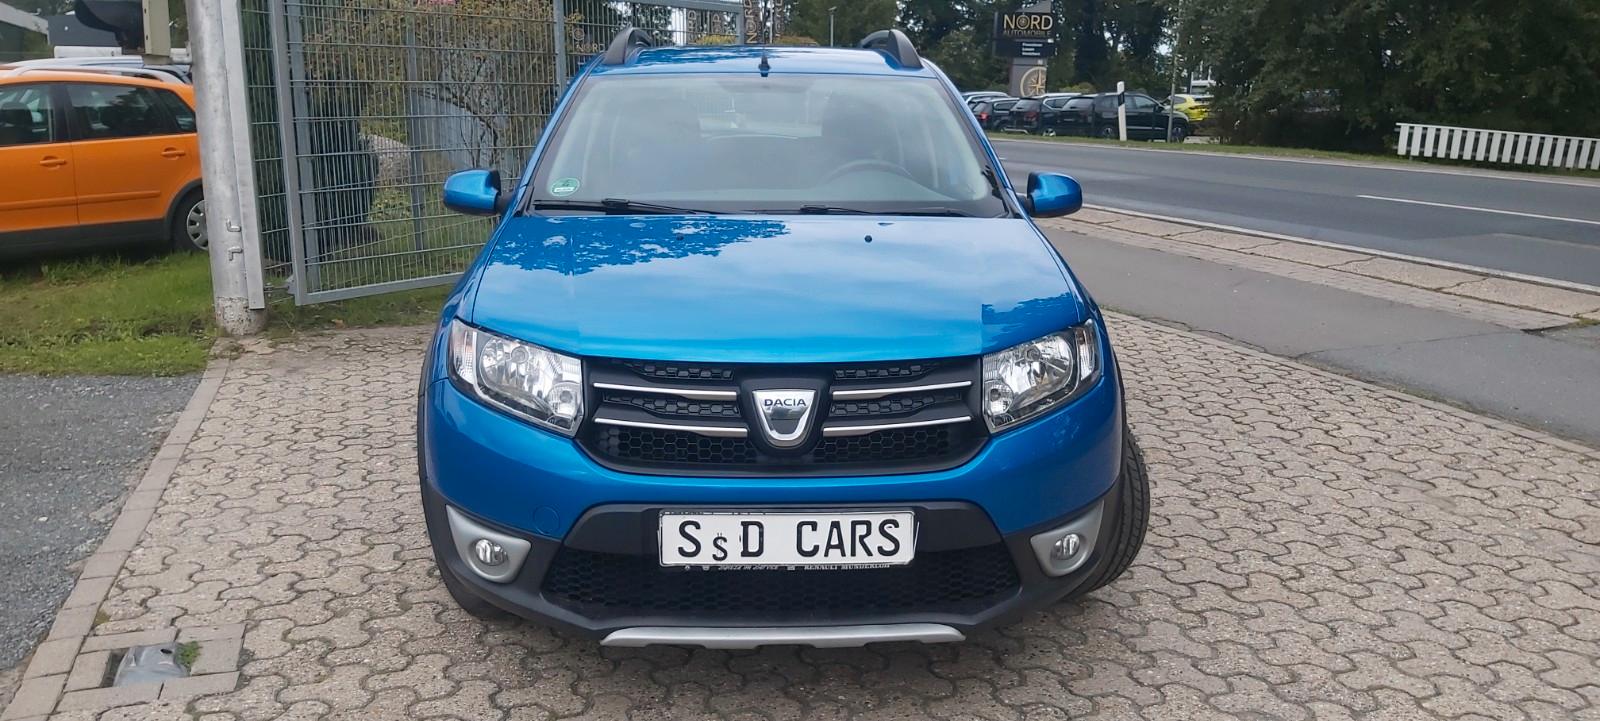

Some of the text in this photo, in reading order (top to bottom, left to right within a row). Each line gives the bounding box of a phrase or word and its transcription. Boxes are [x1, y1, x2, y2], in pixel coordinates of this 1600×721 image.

[1003, 14, 1053, 30] NORD
[764, 398, 807, 407] DACIA
[796, 519, 900, 558] CARS
